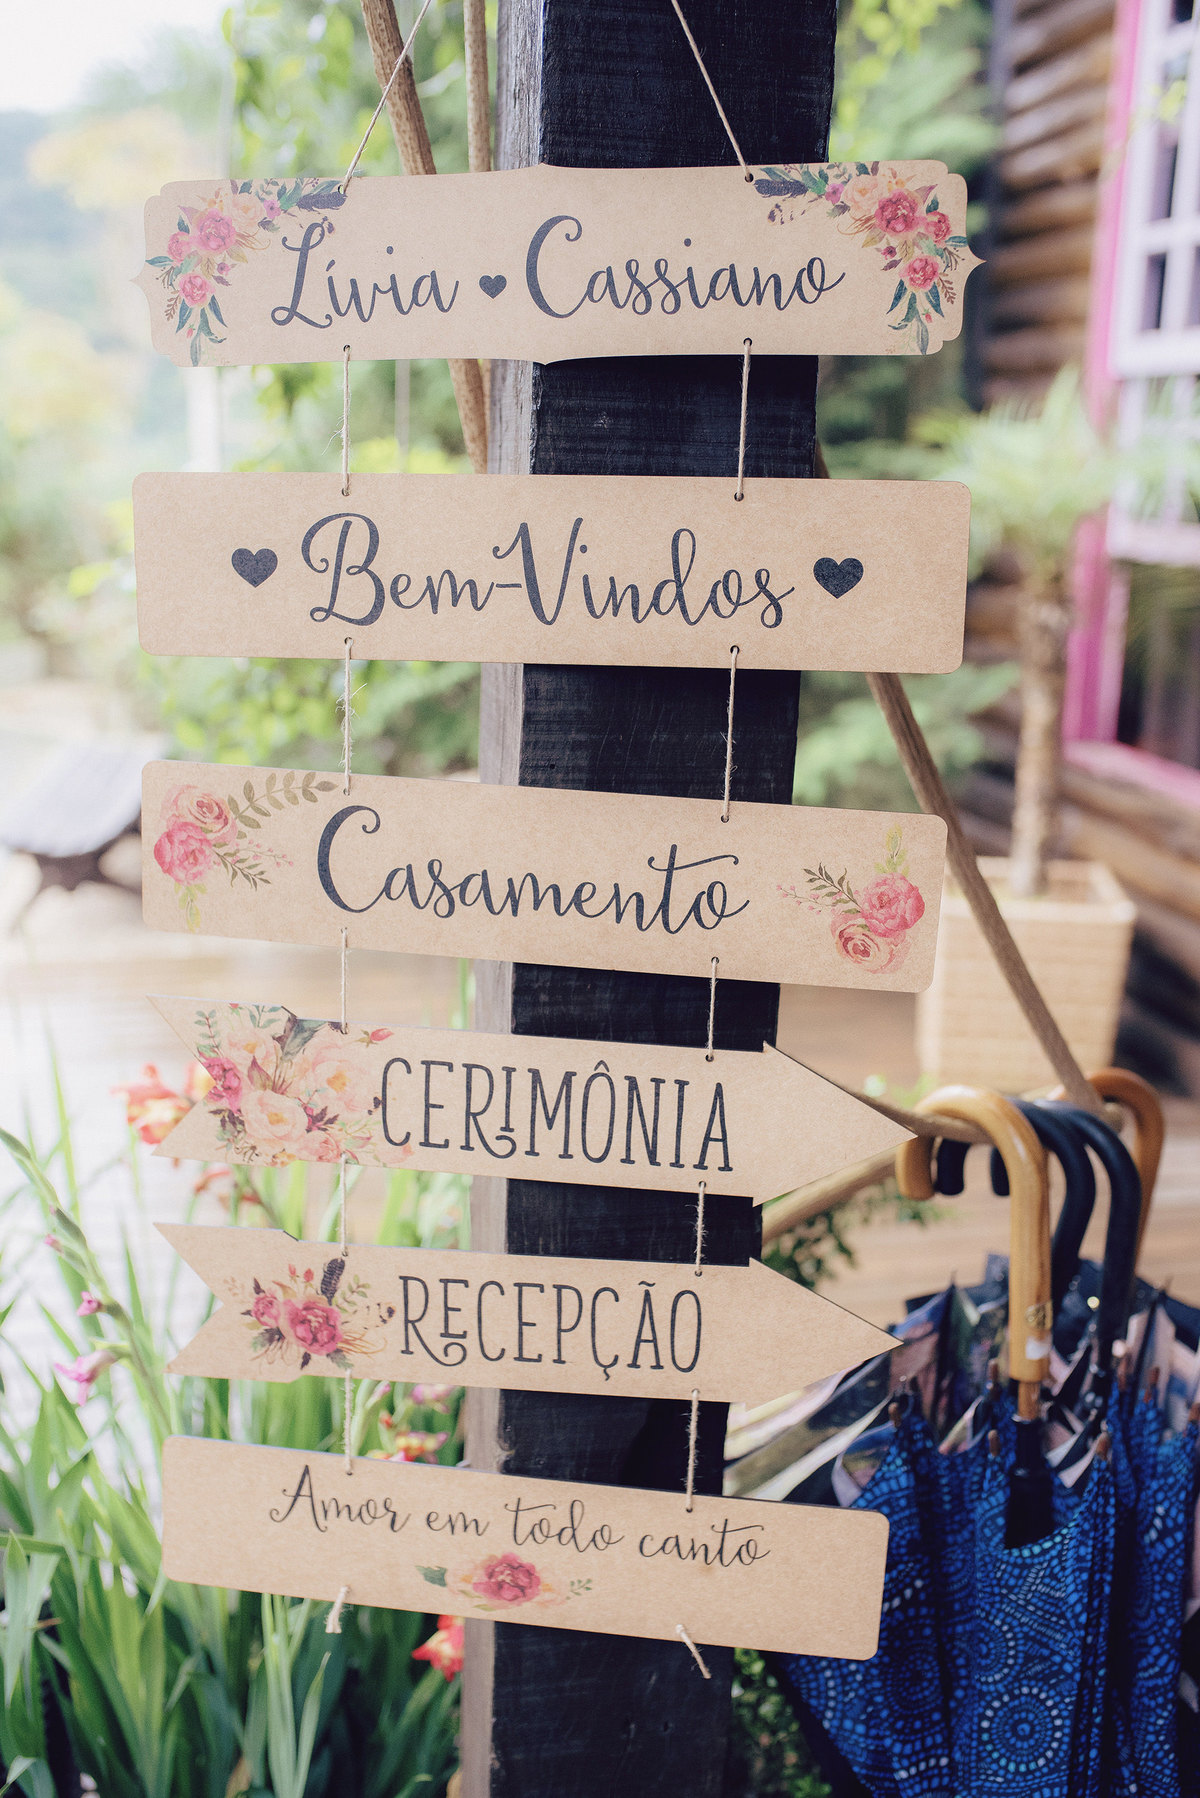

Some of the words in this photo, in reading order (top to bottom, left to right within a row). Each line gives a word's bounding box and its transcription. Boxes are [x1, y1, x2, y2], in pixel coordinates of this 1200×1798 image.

[270, 221, 460, 329] Lívia
[525, 214, 847, 319] Cassiano
[300, 512, 796, 629] Bem-Vindos
[316, 804, 751, 935] Casamento
[380, 1056, 734, 1173] CERIMÔNIA
[398, 1275, 703, 1382] RECEPÇÃO
[269, 1464, 412, 1533] Amor
[425, 1510, 490, 1537] em
[503, 1497, 625, 1553] todo
[638, 1517, 771, 1568] canto
